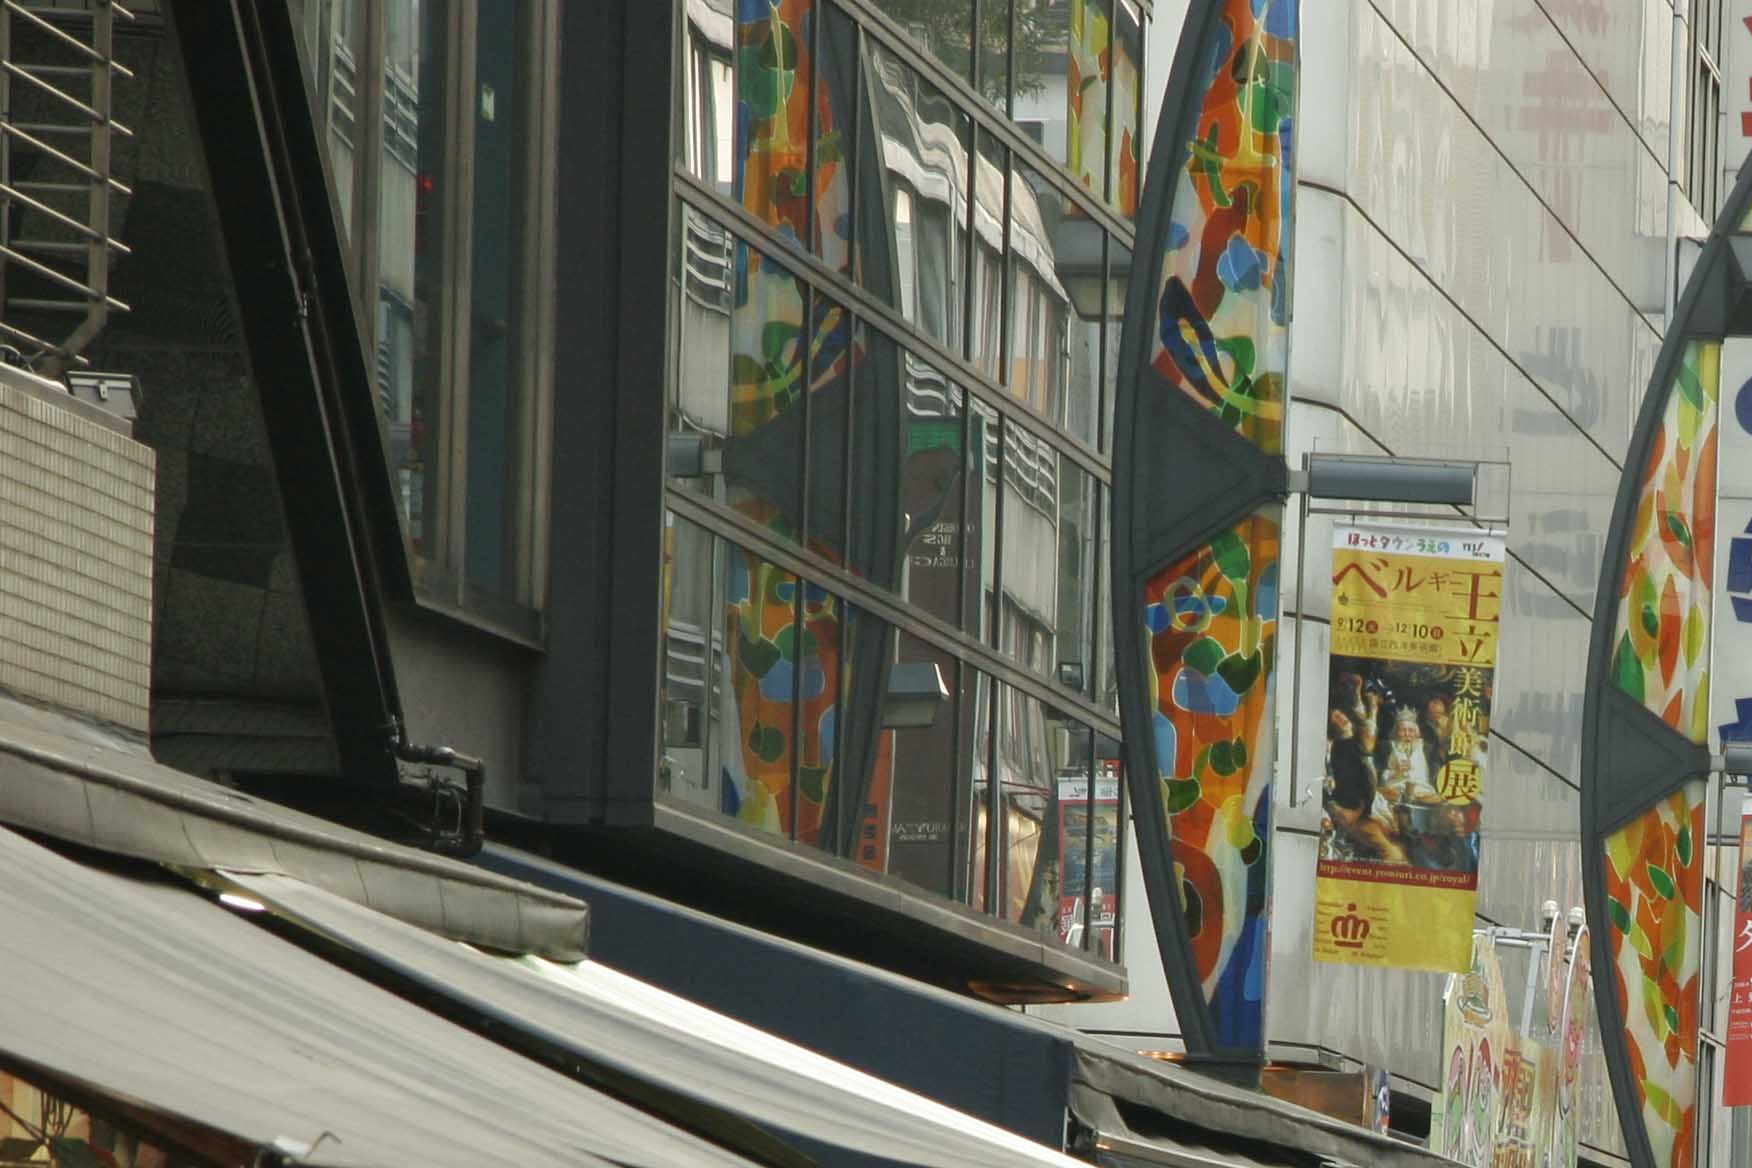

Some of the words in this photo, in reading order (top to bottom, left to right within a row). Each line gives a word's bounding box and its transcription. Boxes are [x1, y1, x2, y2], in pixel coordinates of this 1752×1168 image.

[1346, 533, 1451, 554] ほっとタウンうえの
